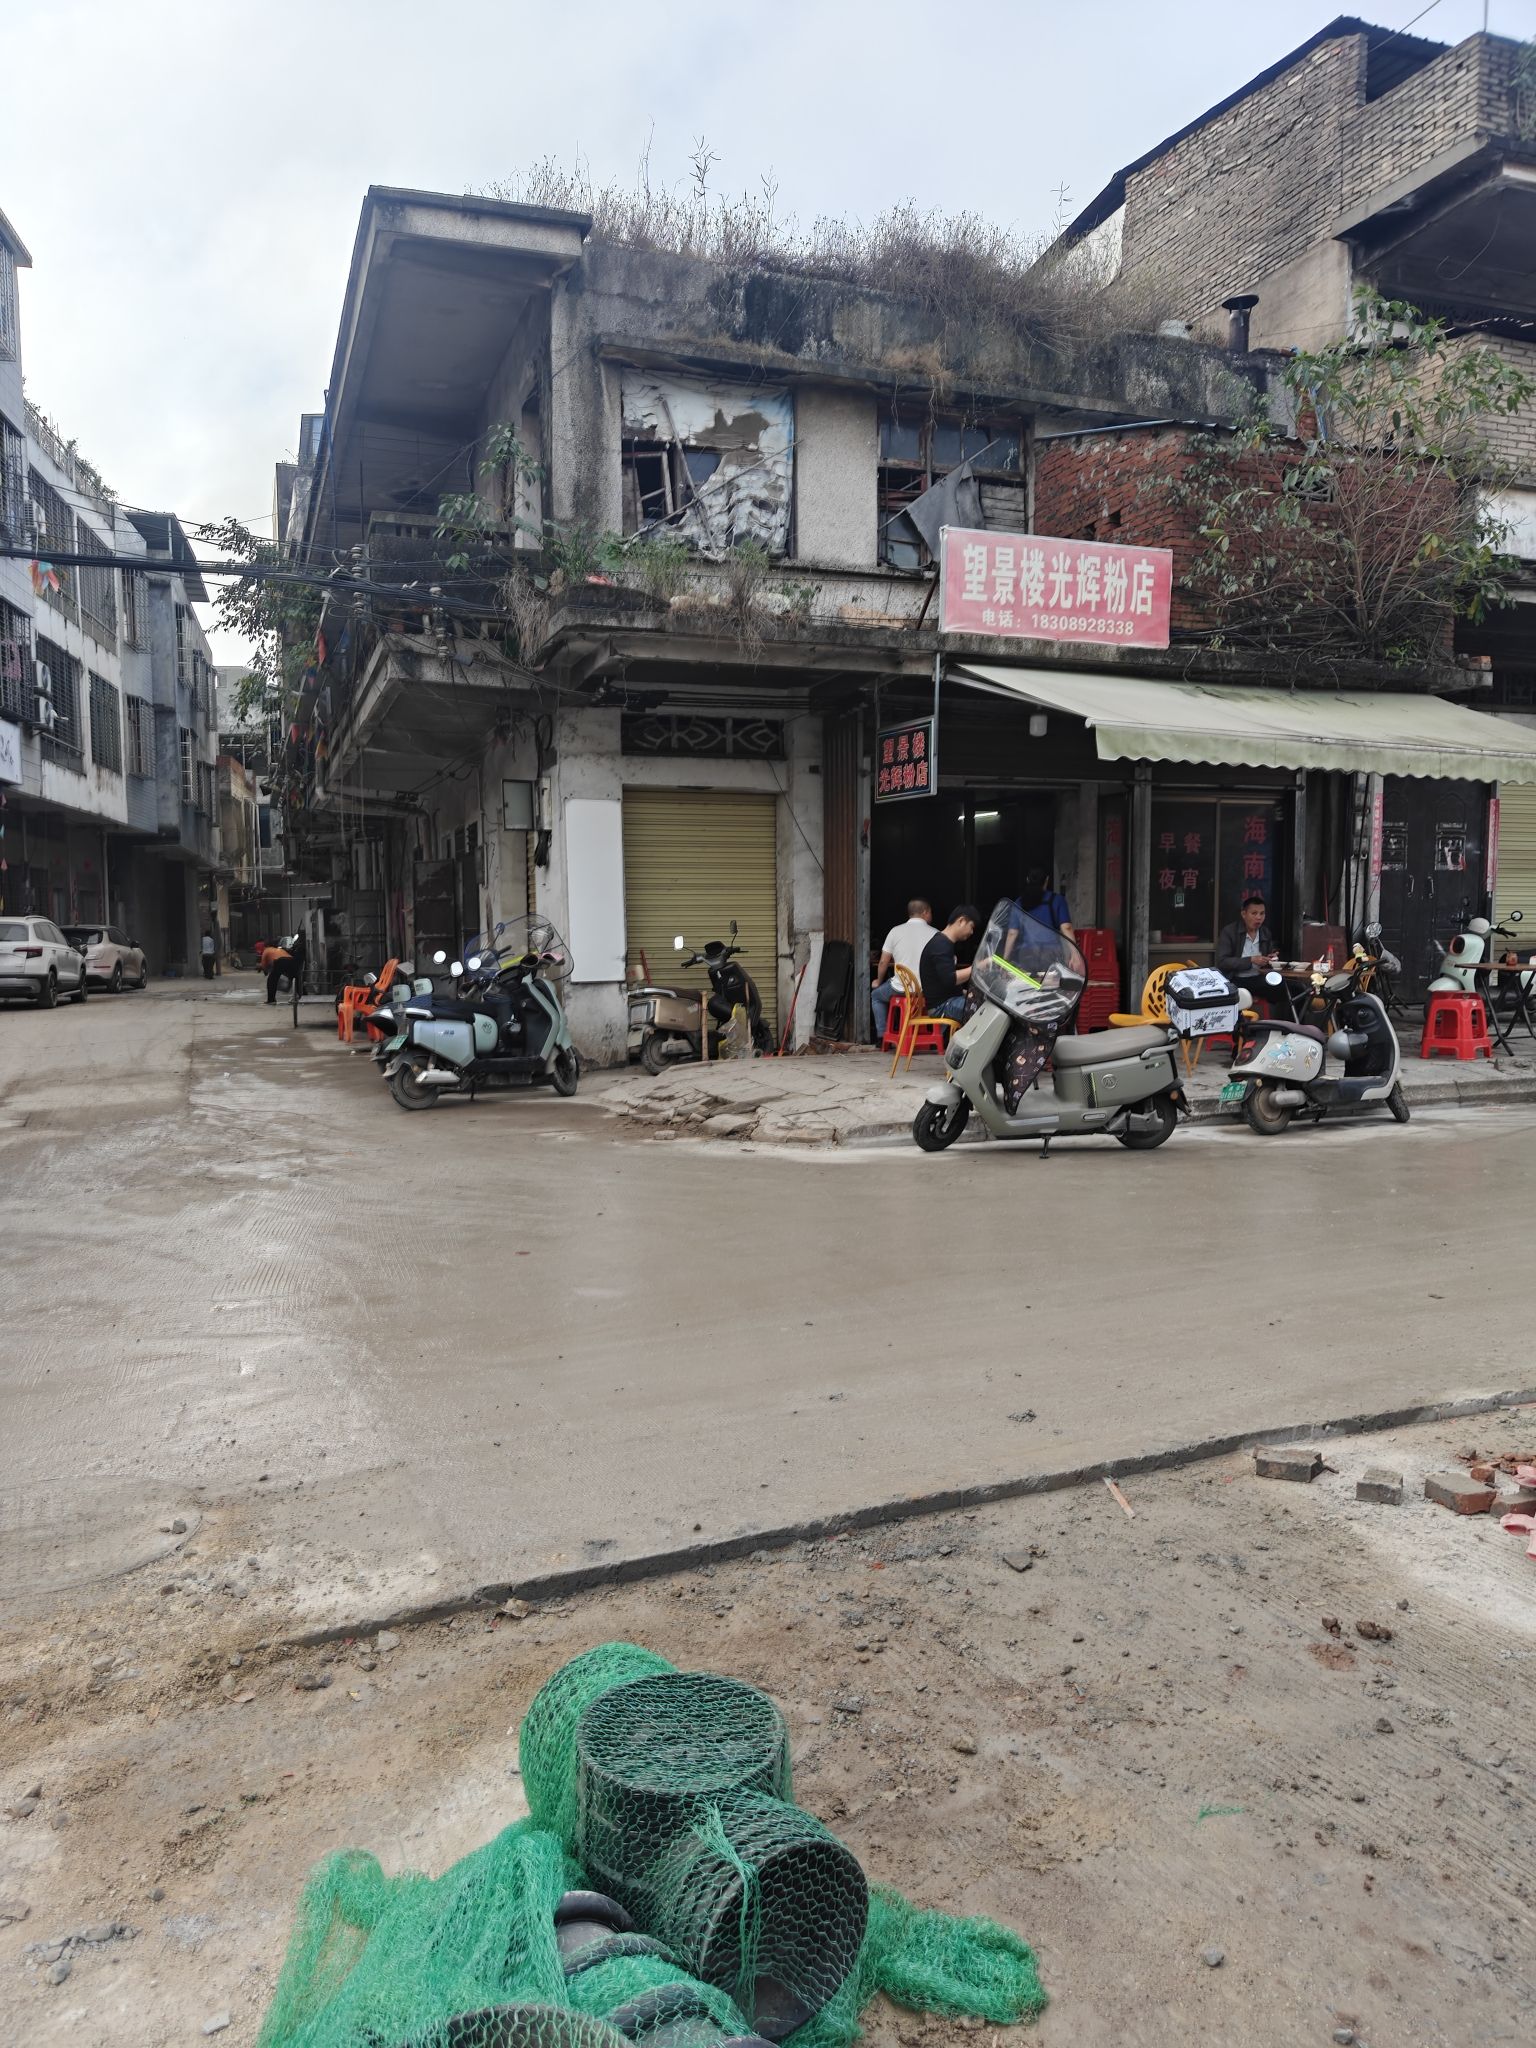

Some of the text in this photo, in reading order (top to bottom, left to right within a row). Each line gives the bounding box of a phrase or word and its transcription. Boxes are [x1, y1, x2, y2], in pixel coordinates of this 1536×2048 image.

[962, 543, 1155, 616] 望景楼光辉粉店
[1159, 832, 1201, 854] 早餐
[1159, 868, 1200, 890] 夜宵
